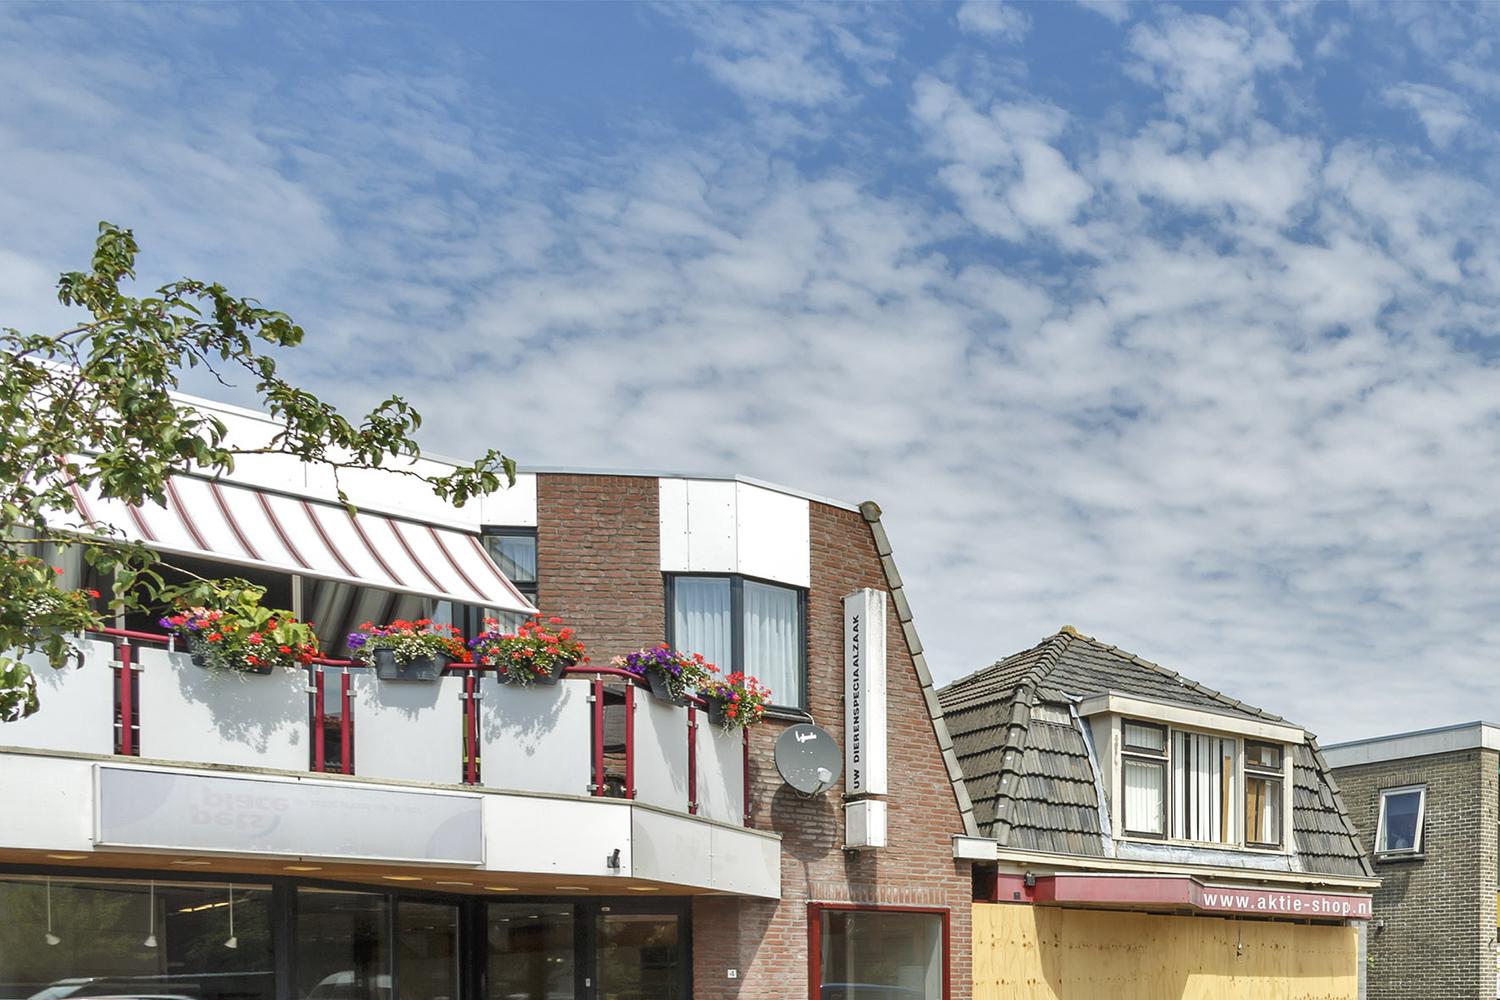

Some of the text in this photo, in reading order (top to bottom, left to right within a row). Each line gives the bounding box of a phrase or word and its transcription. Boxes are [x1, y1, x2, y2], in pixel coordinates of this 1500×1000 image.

[853, 614, 861, 790] UW DIERENSPECIAALZAAK
[1203, 893, 1372, 916] www.aktie-shop.nl
